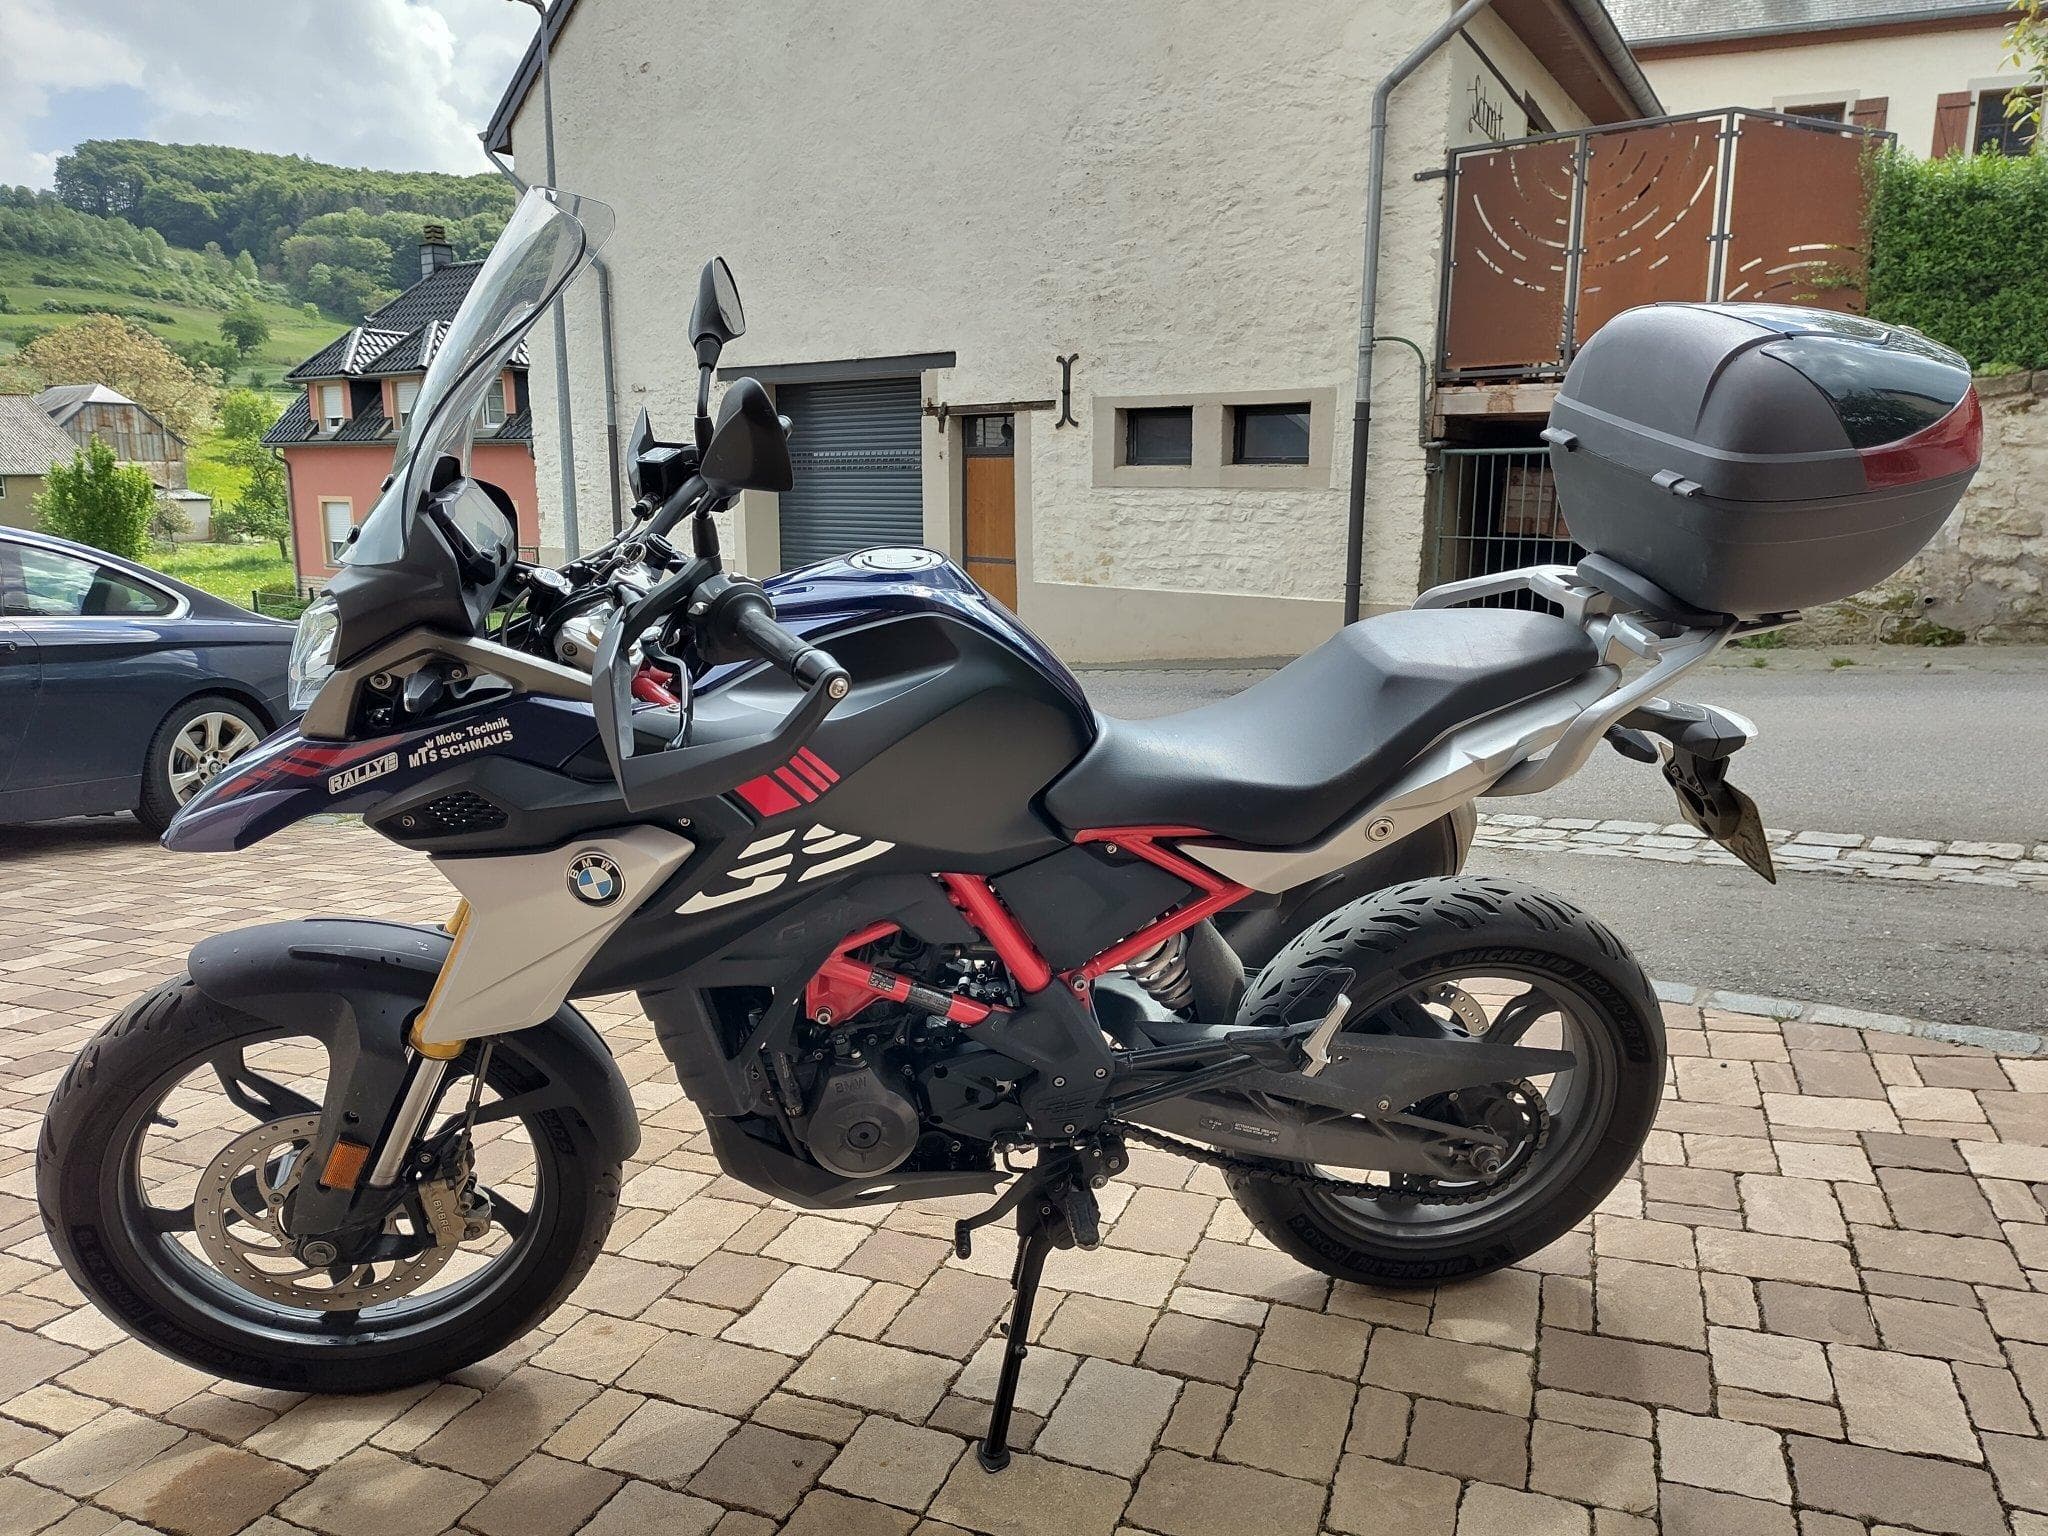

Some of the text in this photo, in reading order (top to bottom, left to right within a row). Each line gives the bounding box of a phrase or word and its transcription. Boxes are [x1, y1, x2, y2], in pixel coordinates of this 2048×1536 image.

[466, 716, 510, 737] Technik
[408, 730, 514, 769] MTS SCHMAUS
[1451, 949, 1575, 974] MICHELIN
[833, 1076, 867, 1094] BMW
[432, 1198, 451, 1233] BYBRE
